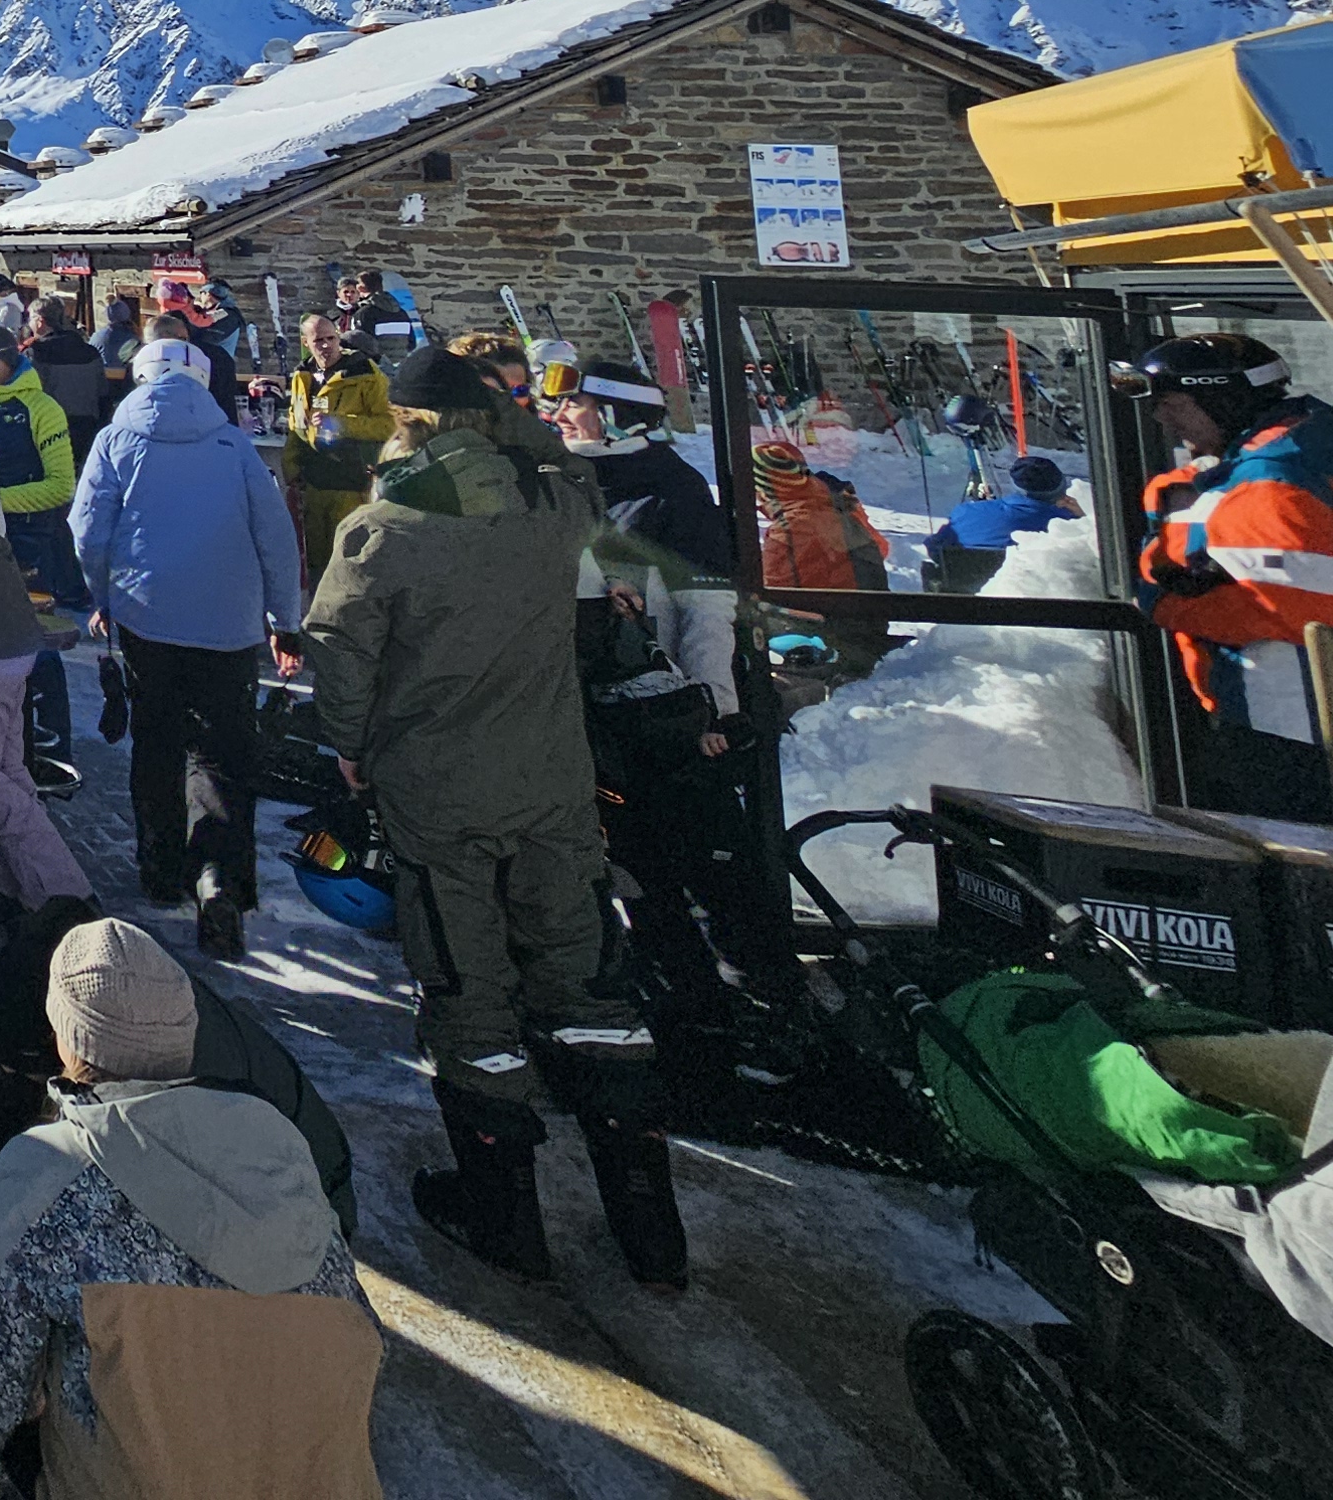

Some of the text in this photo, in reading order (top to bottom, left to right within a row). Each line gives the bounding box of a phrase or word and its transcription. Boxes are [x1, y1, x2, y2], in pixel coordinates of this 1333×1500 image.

[751, 151, 765, 160] FIS
[153, 253, 202, 268] Zur Skischule
[987, 882, 1022, 913] KOLA
[1082, 903, 1236, 951] VIVI KOLA
